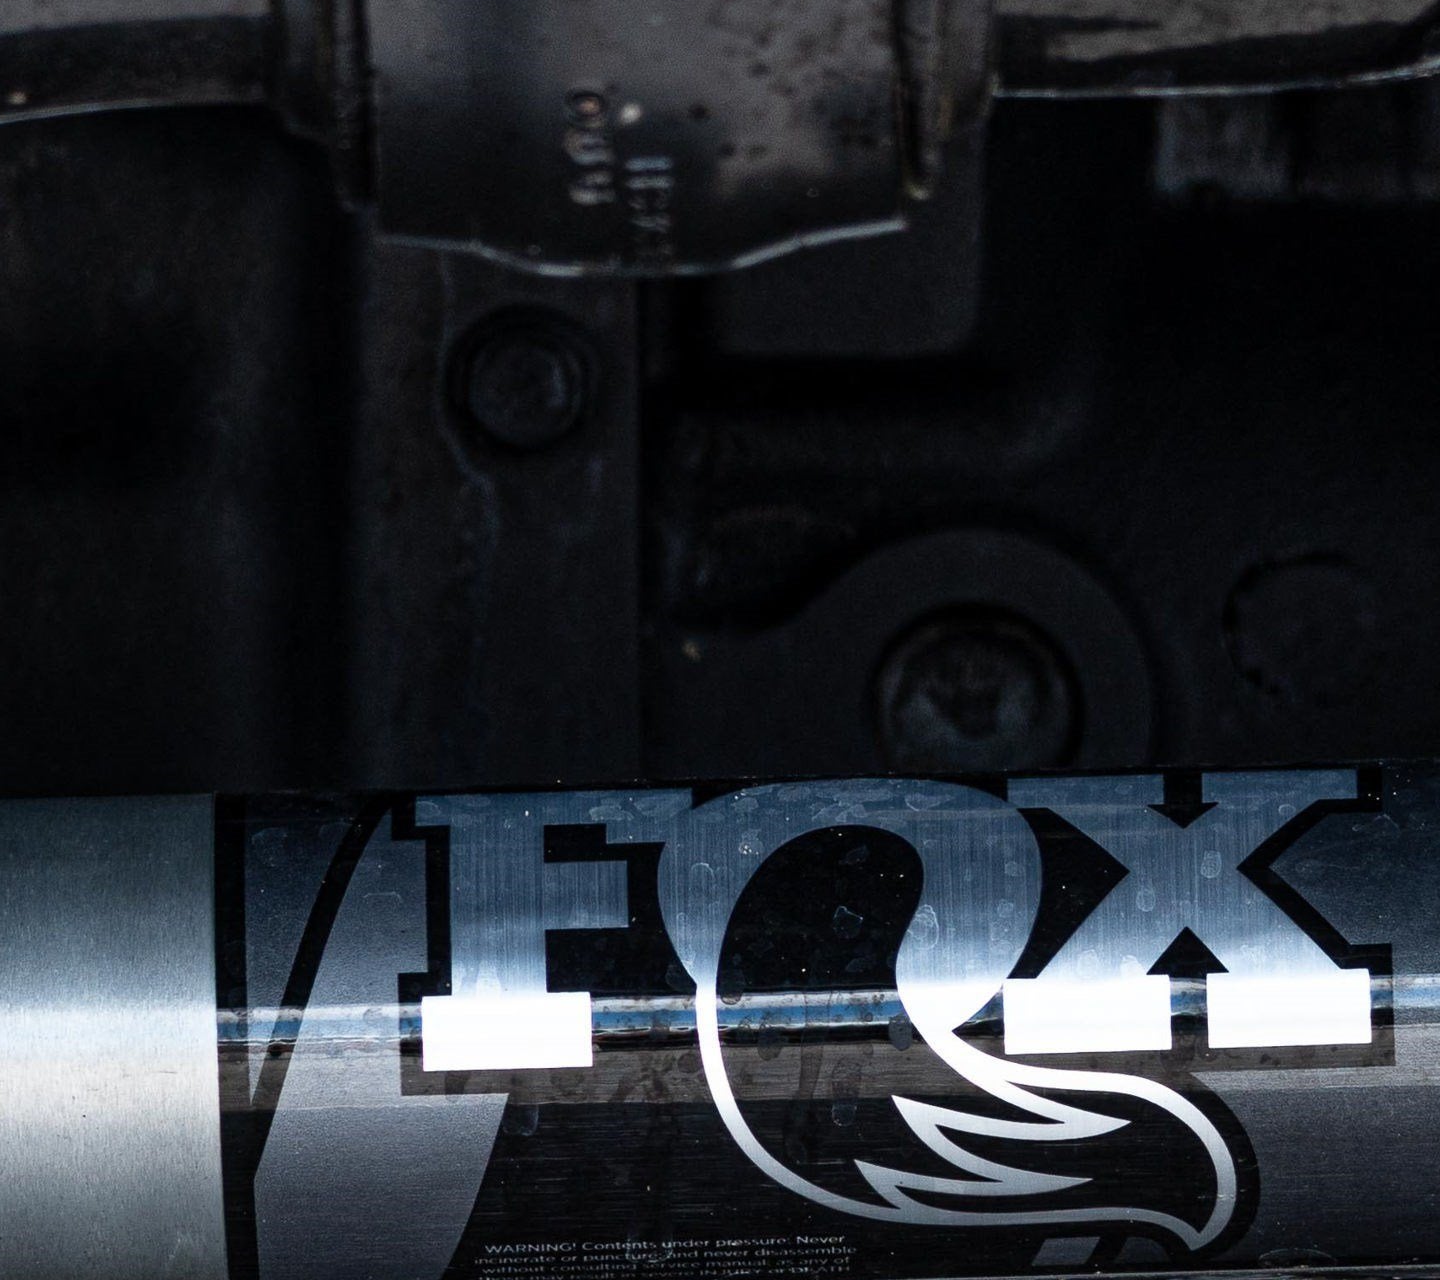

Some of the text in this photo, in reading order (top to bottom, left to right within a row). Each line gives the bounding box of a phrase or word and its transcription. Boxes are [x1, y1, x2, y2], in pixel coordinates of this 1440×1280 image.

[415, 768, 1372, 1250] FOX
[484, 1242, 577, 1254] WARNING!
[581, 1240, 657, 1251] Contents
[661, 1238, 710, 1249] under
[796, 1234, 846, 1245] Never
[474, 1254, 556, 1265] incinerate
[560, 1254, 578, 1262] or
[703, 1249, 749, 1258] never
